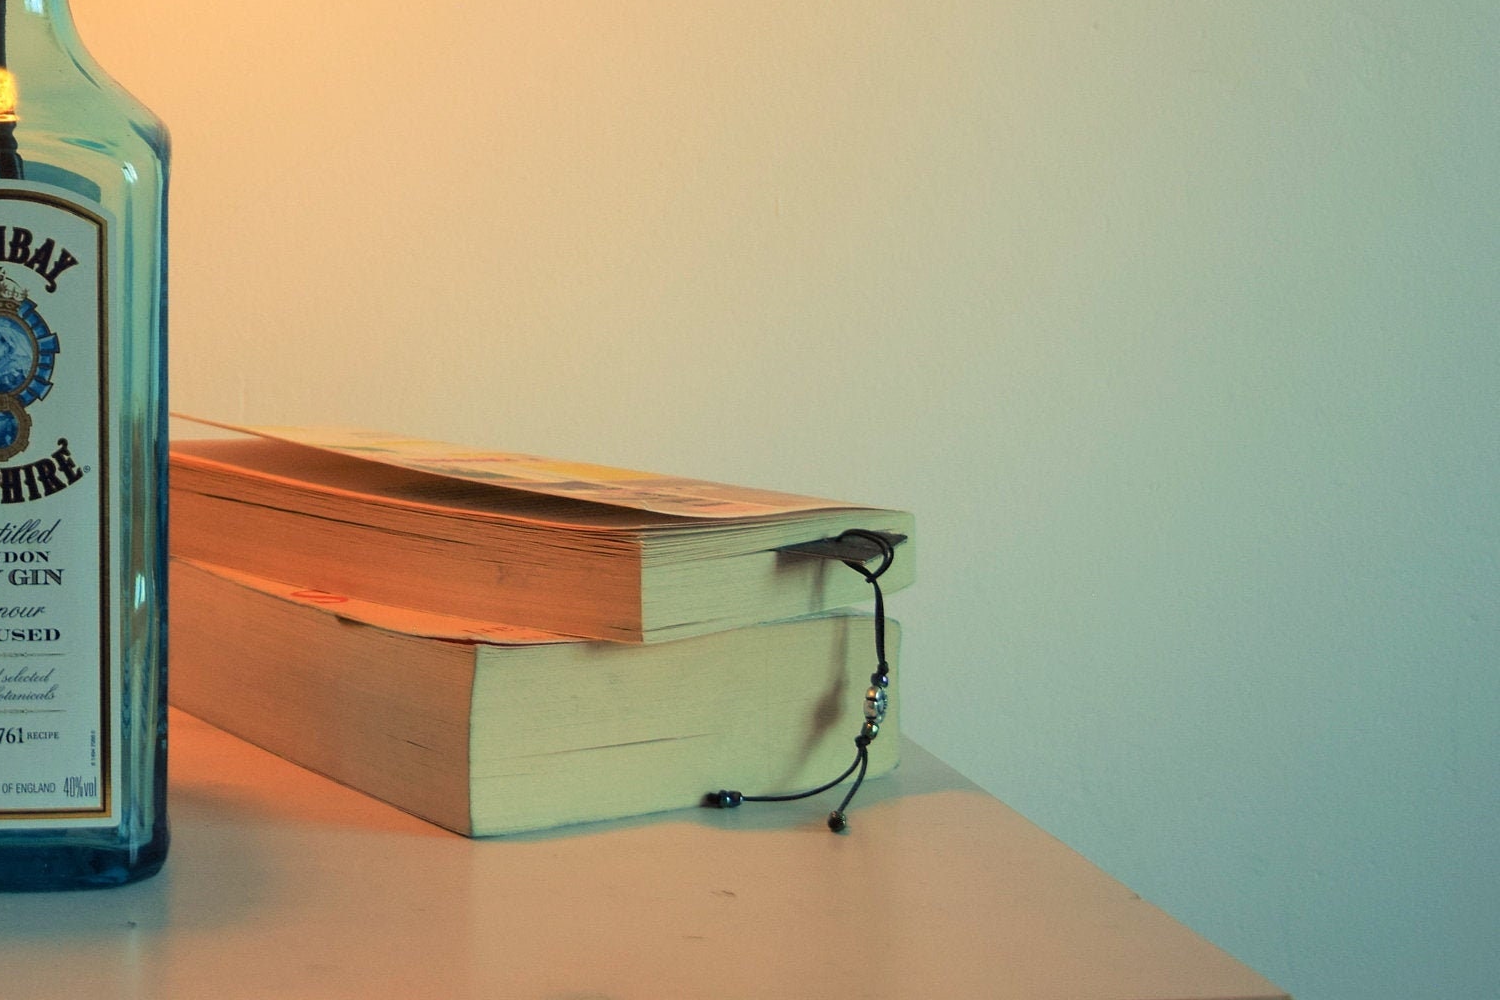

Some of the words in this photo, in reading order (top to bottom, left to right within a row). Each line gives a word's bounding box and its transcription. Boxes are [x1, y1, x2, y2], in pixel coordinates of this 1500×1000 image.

[7, 568, 65, 586] GIN
[0, 665, 52, 683] selected
[26, 731, 60, 741] RECIPE
[1, 782, 14, 794] OF
[15, 782, 56, 794] ENGLAND
